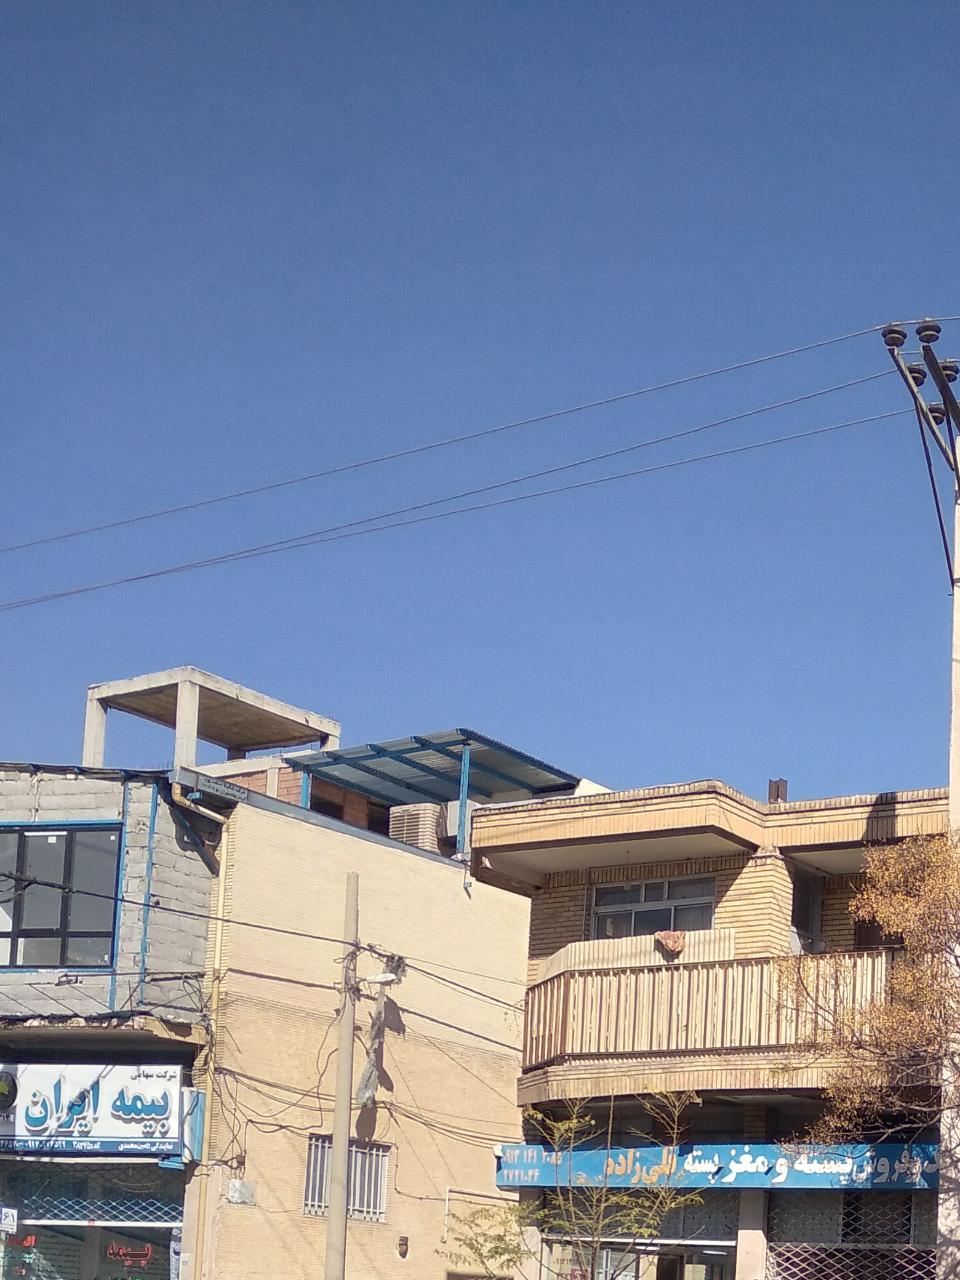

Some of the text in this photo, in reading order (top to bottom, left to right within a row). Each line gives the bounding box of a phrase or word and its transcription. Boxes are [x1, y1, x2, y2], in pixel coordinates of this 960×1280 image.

[130, 1070, 177, 1082] شرکت سهامی
[24, 1077, 172, 1135] بیمه ایران
[683, 1150, 720, 1184] پسته
[720, 1145, 769, 1183] مغز
[771, 1157, 790, 1183] و
[4, 1211, 15, 1223] ۶۱
